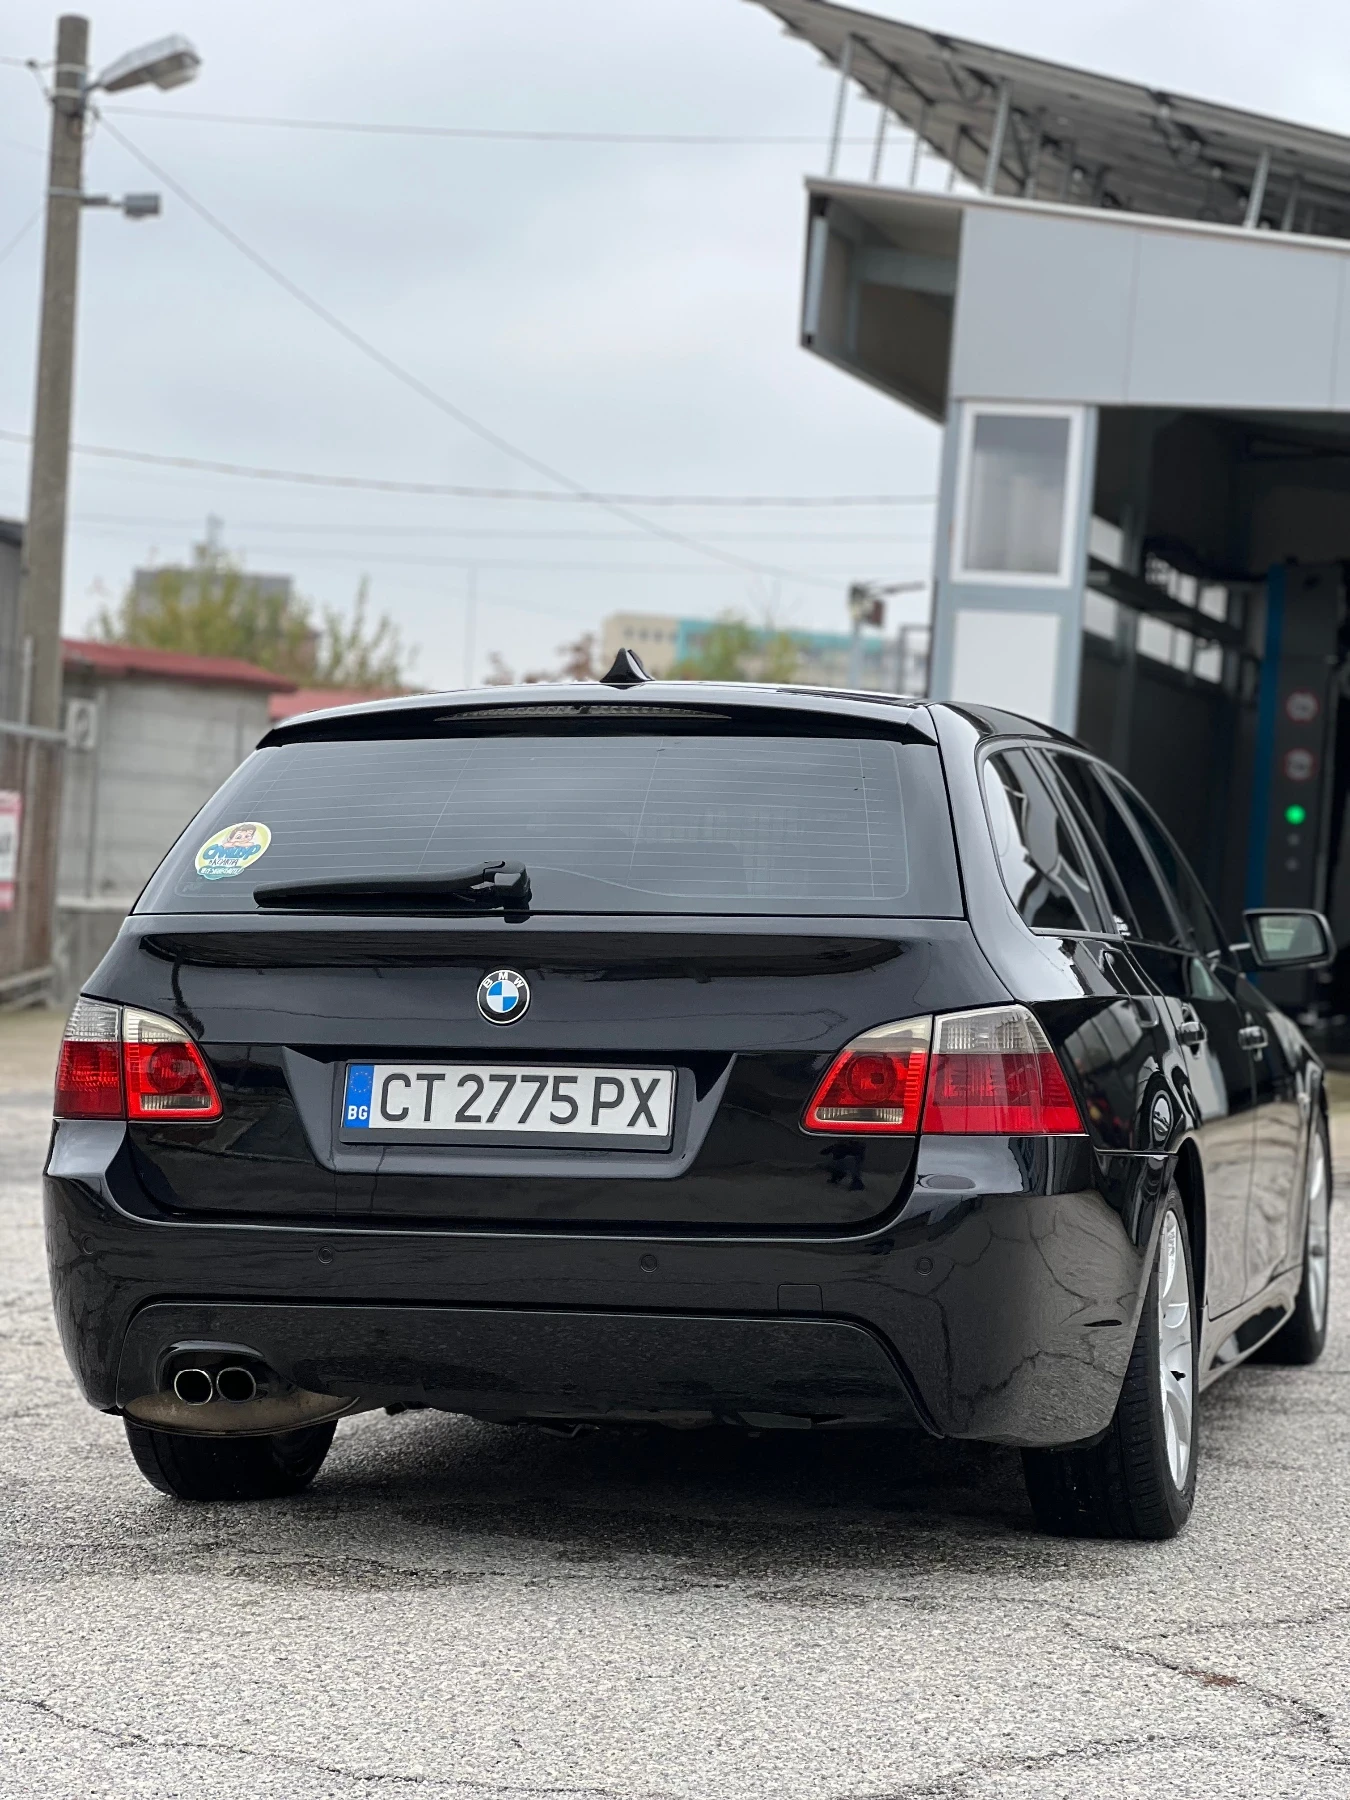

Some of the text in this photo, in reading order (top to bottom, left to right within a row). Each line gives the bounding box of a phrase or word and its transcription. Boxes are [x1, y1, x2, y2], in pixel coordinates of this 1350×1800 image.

[482, 972, 525, 989] BMW
[380, 1073, 661, 1128] CT 2775 PX
[347, 1105, 368, 1120] BG
